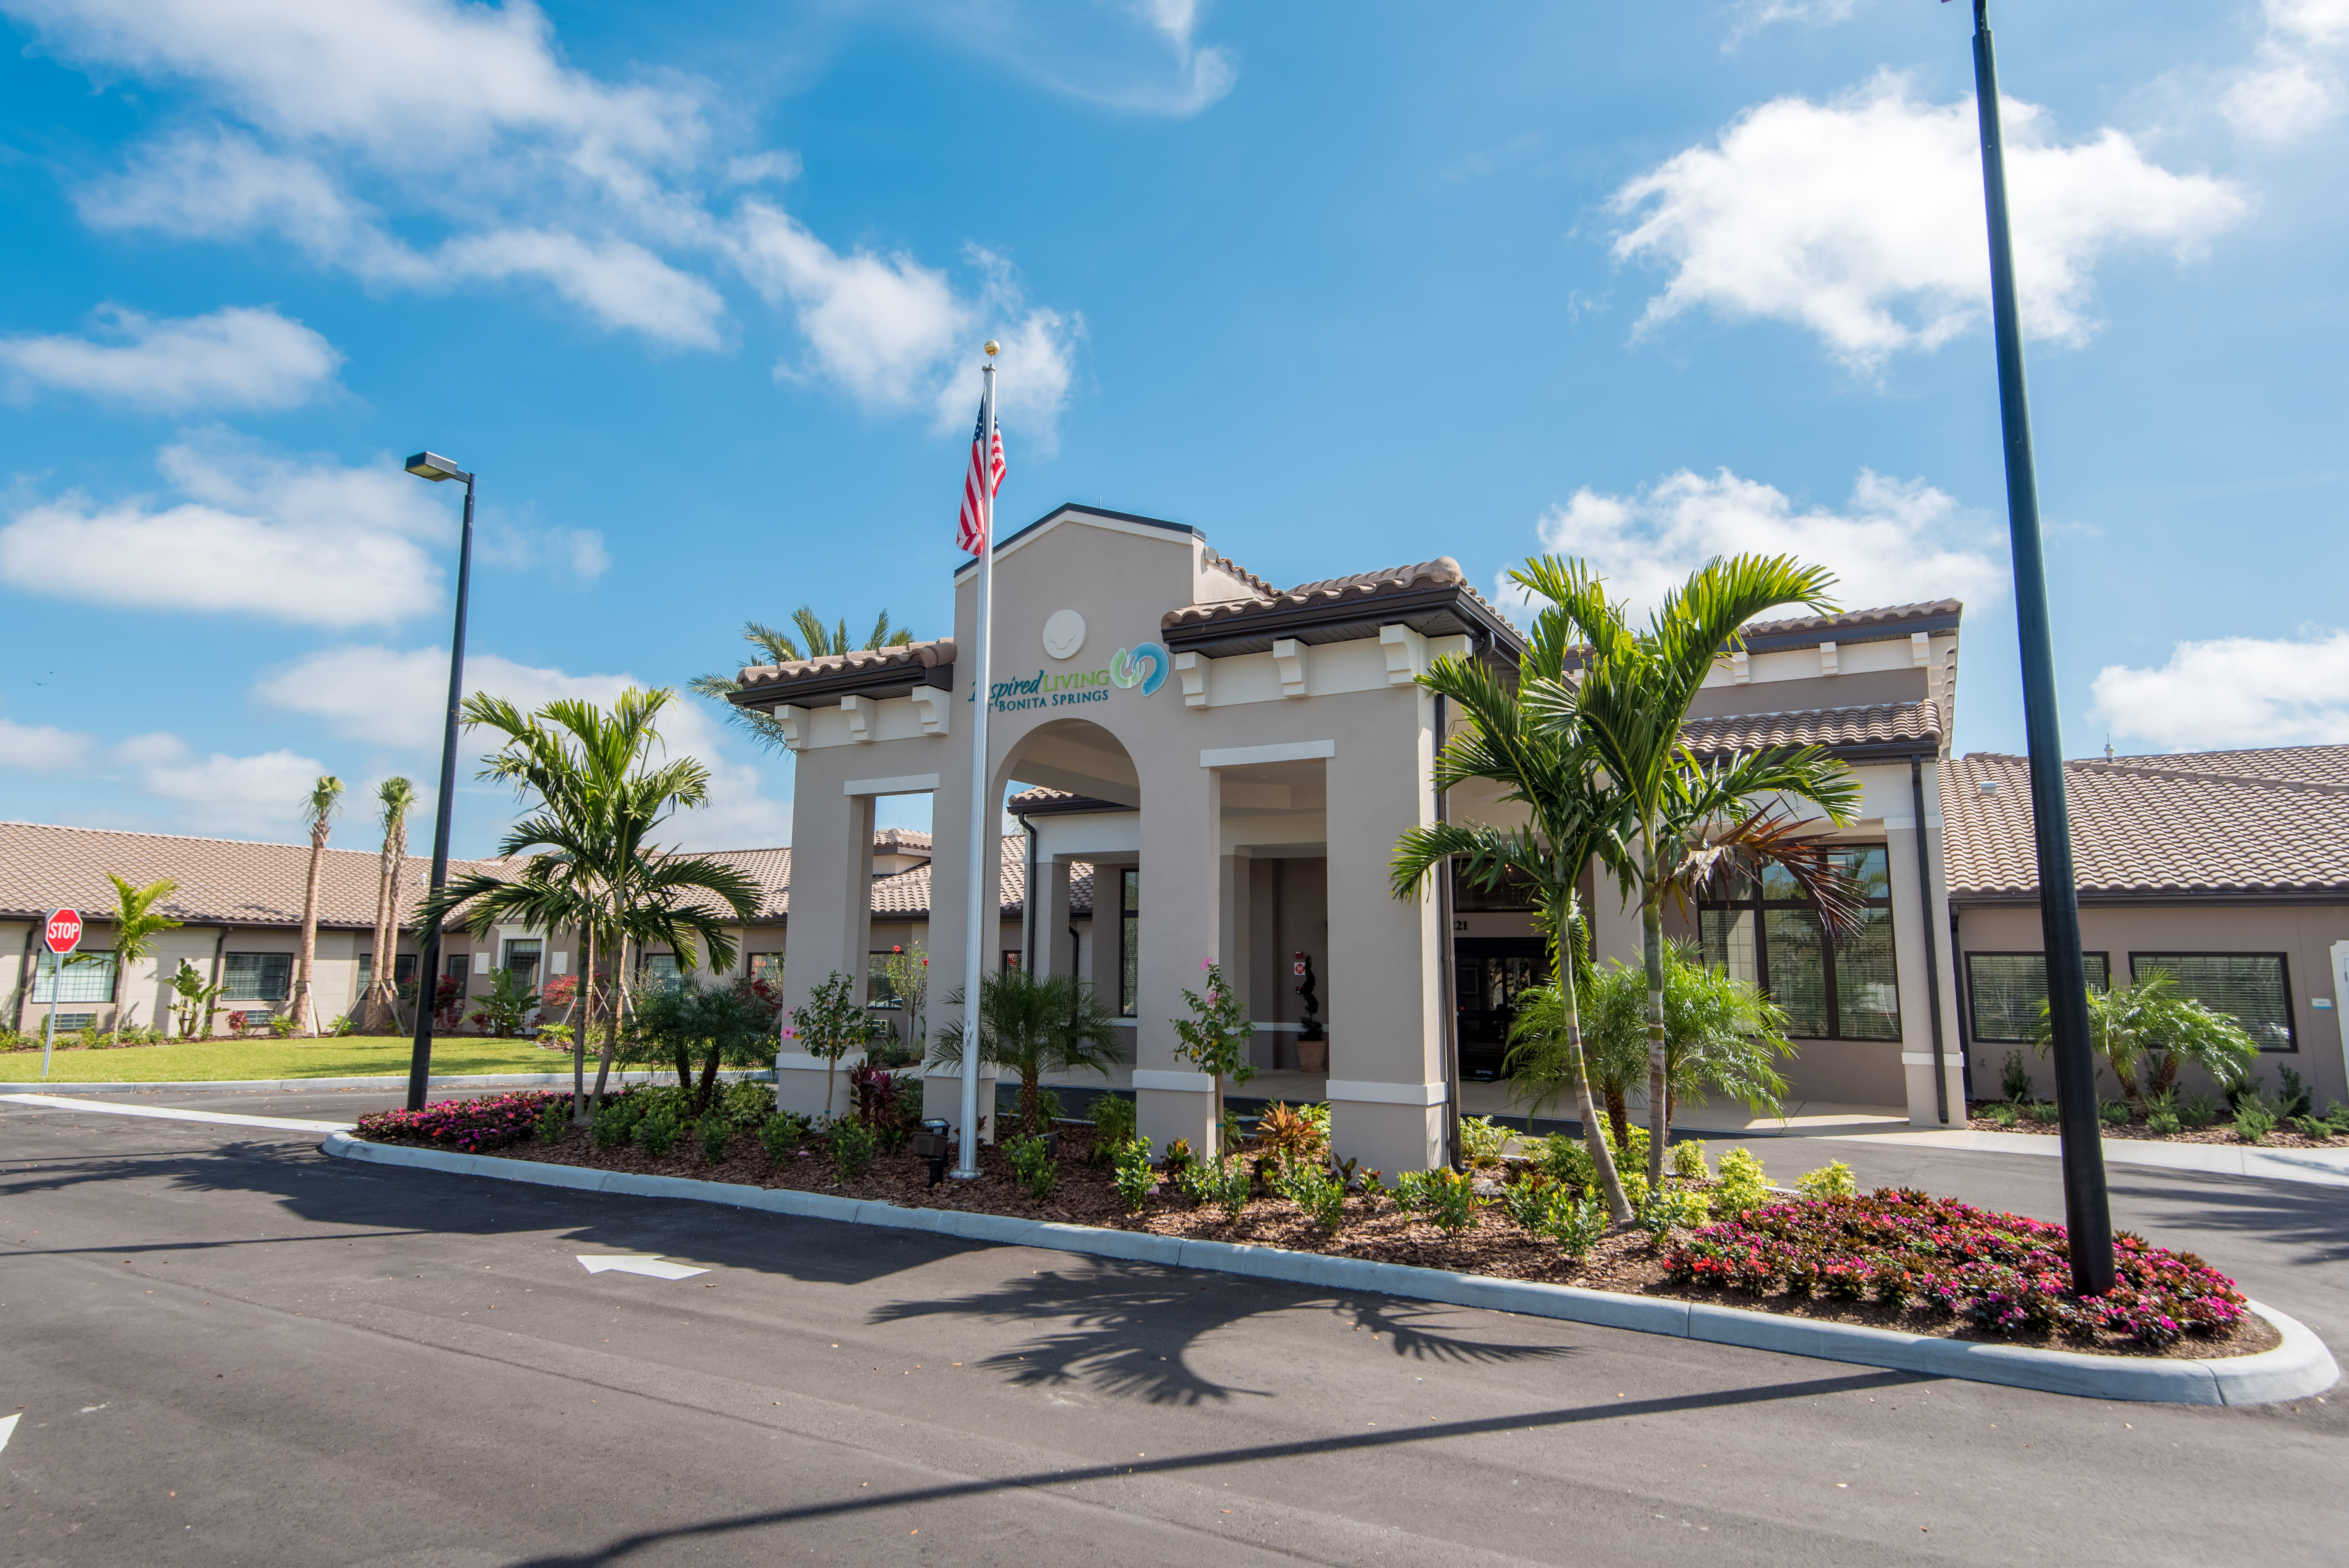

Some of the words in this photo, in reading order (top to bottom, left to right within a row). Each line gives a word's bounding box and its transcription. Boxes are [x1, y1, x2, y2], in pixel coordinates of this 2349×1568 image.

[968, 670, 1044, 707] spired
[1043, 670, 1109, 692] LIVING
[999, 697, 1047, 712] BONITA
[1052, 690, 1108, 706] SPRINGS
[49, 922, 79, 939] STOP
